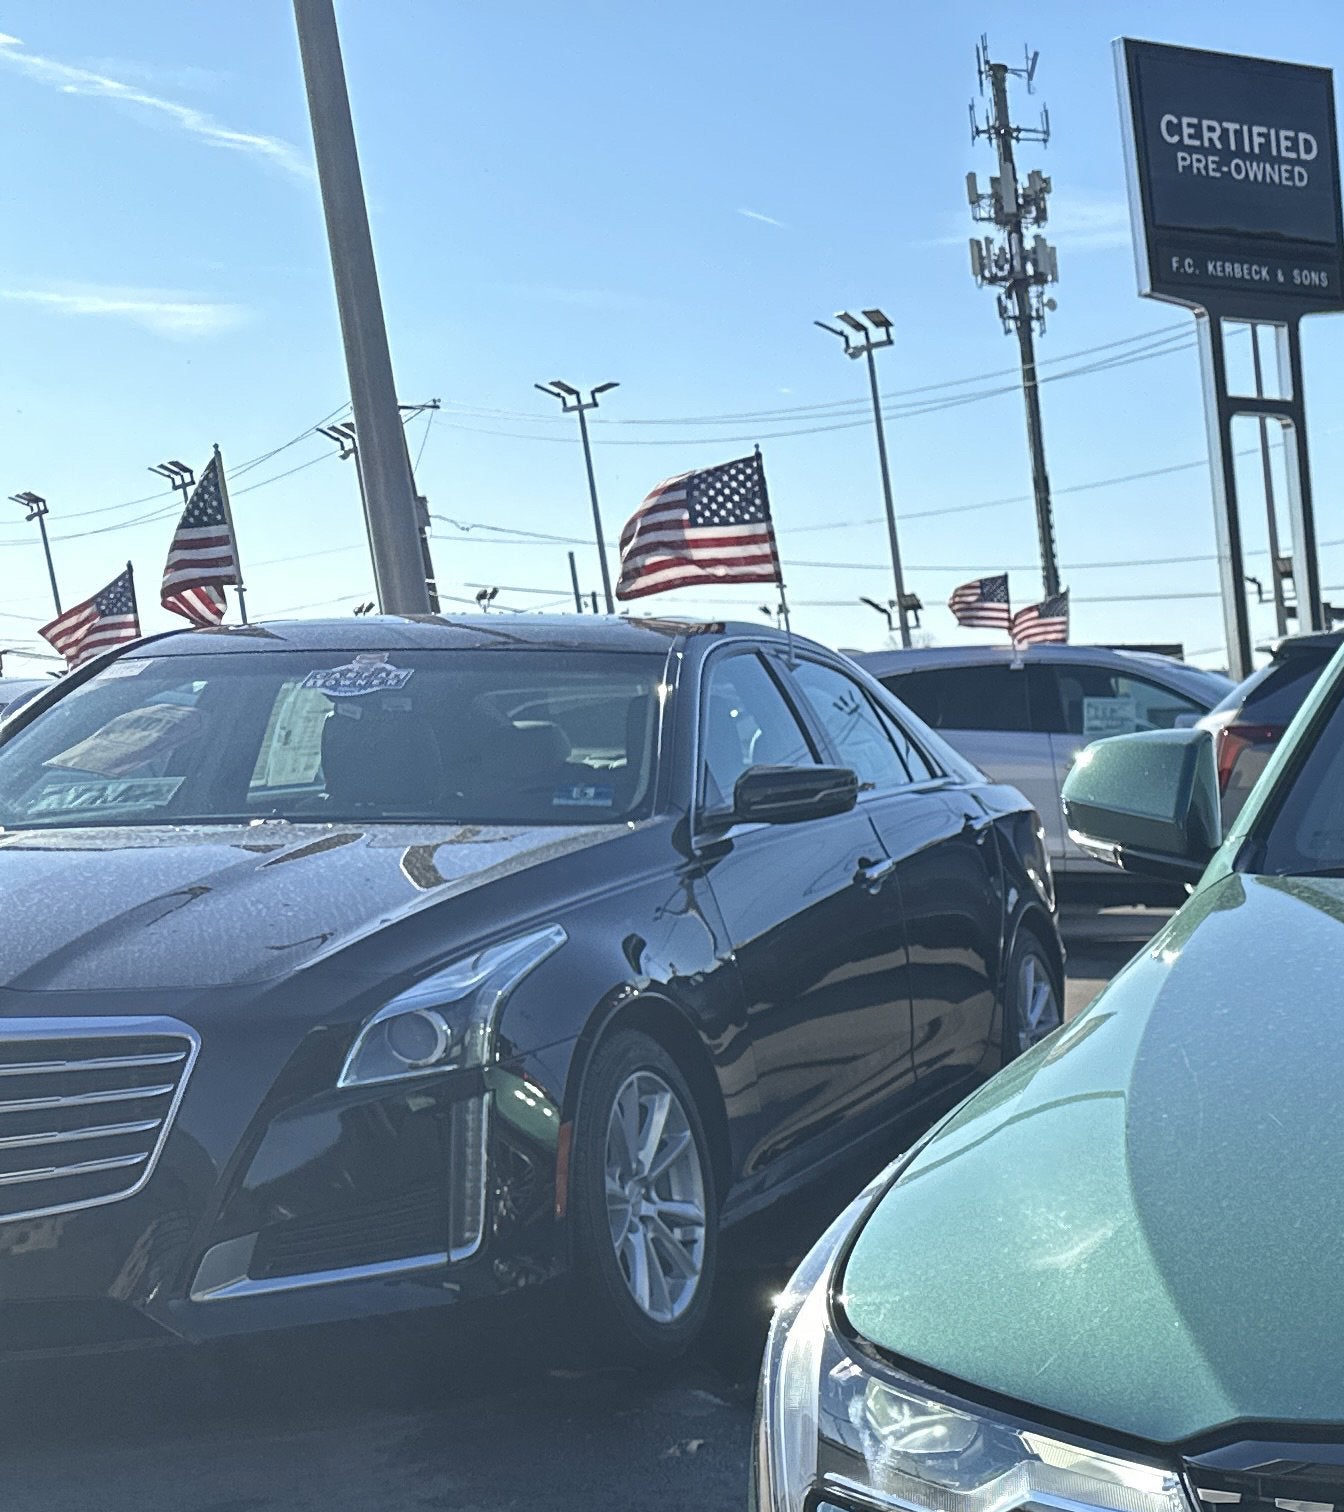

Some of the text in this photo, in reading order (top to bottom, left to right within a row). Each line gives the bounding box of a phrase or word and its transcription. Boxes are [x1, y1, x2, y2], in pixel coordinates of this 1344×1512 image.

[1160, 113, 1318, 161] CERTIFIED
[1177, 151, 1308, 187] PRE-OWNED
[1171, 256, 1328, 288] F.C. KERBECK & SONS
